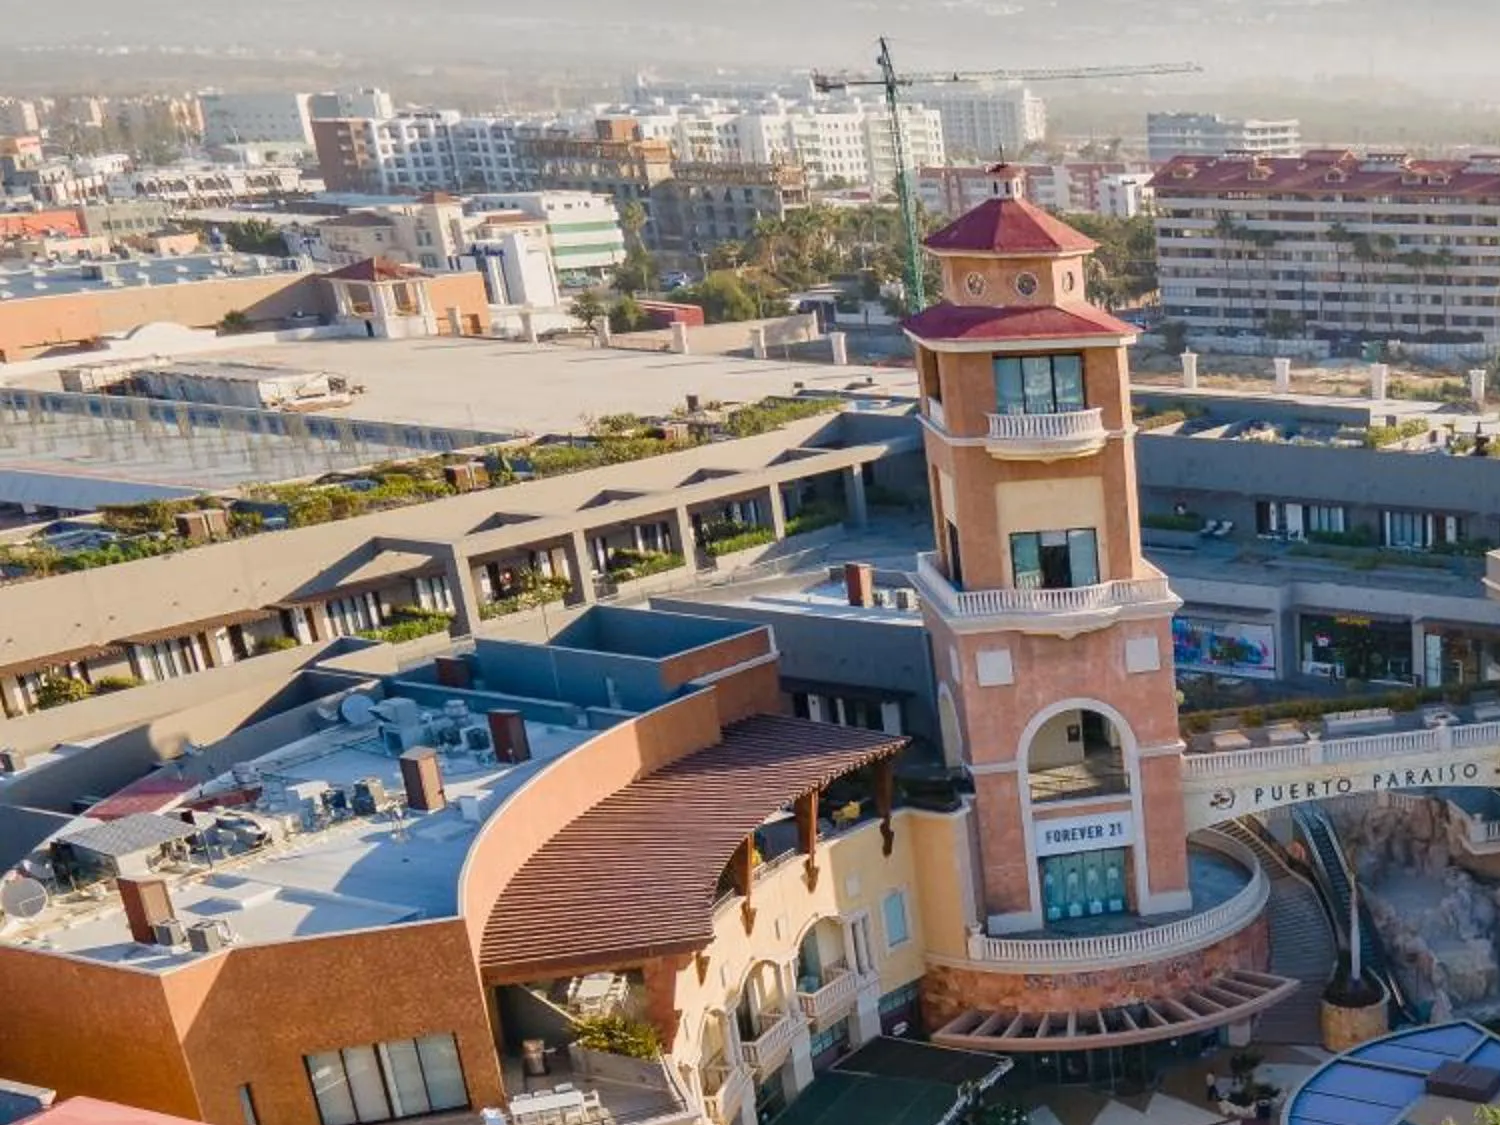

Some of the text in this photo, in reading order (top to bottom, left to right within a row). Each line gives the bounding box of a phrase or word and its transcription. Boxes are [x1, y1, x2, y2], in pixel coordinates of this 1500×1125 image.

[1254, 763, 1479, 804] PUERTO PARAISO
[1045, 822, 1123, 844] FOREVER 21
